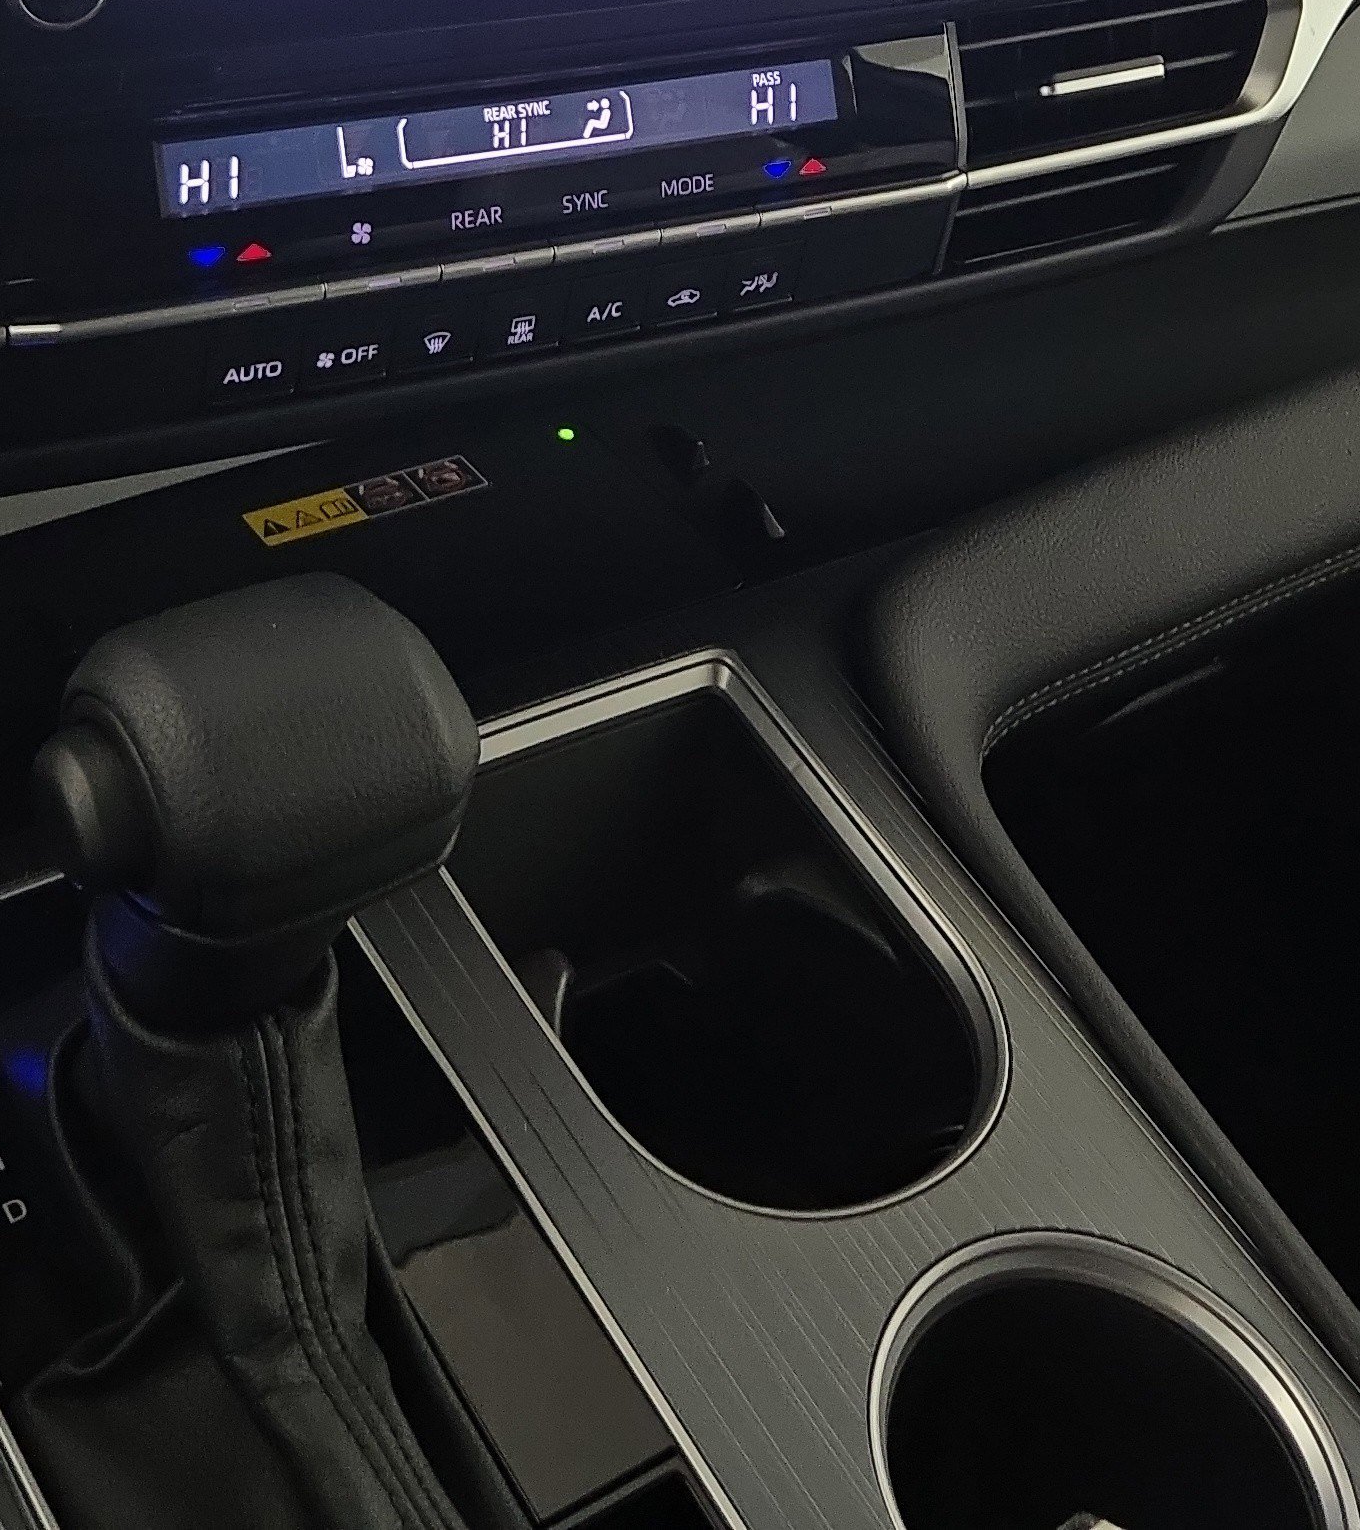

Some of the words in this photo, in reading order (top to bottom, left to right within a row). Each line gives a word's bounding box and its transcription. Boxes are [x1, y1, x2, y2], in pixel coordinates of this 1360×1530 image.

[751, 70, 782, 88] PASS
[483, 105, 516, 123] REAR
[517, 99, 552, 118] SYNC
[661, 173, 715, 198] MODE
[562, 190, 610, 214] SYNC
[451, 206, 504, 231] REAR
[587, 301, 623, 323] A/C
[507, 331, 534, 346] REAR
[340, 343, 379, 365] OFF
[223, 360, 283, 385] AUTO
[2, 1199, 28, 1224] D
